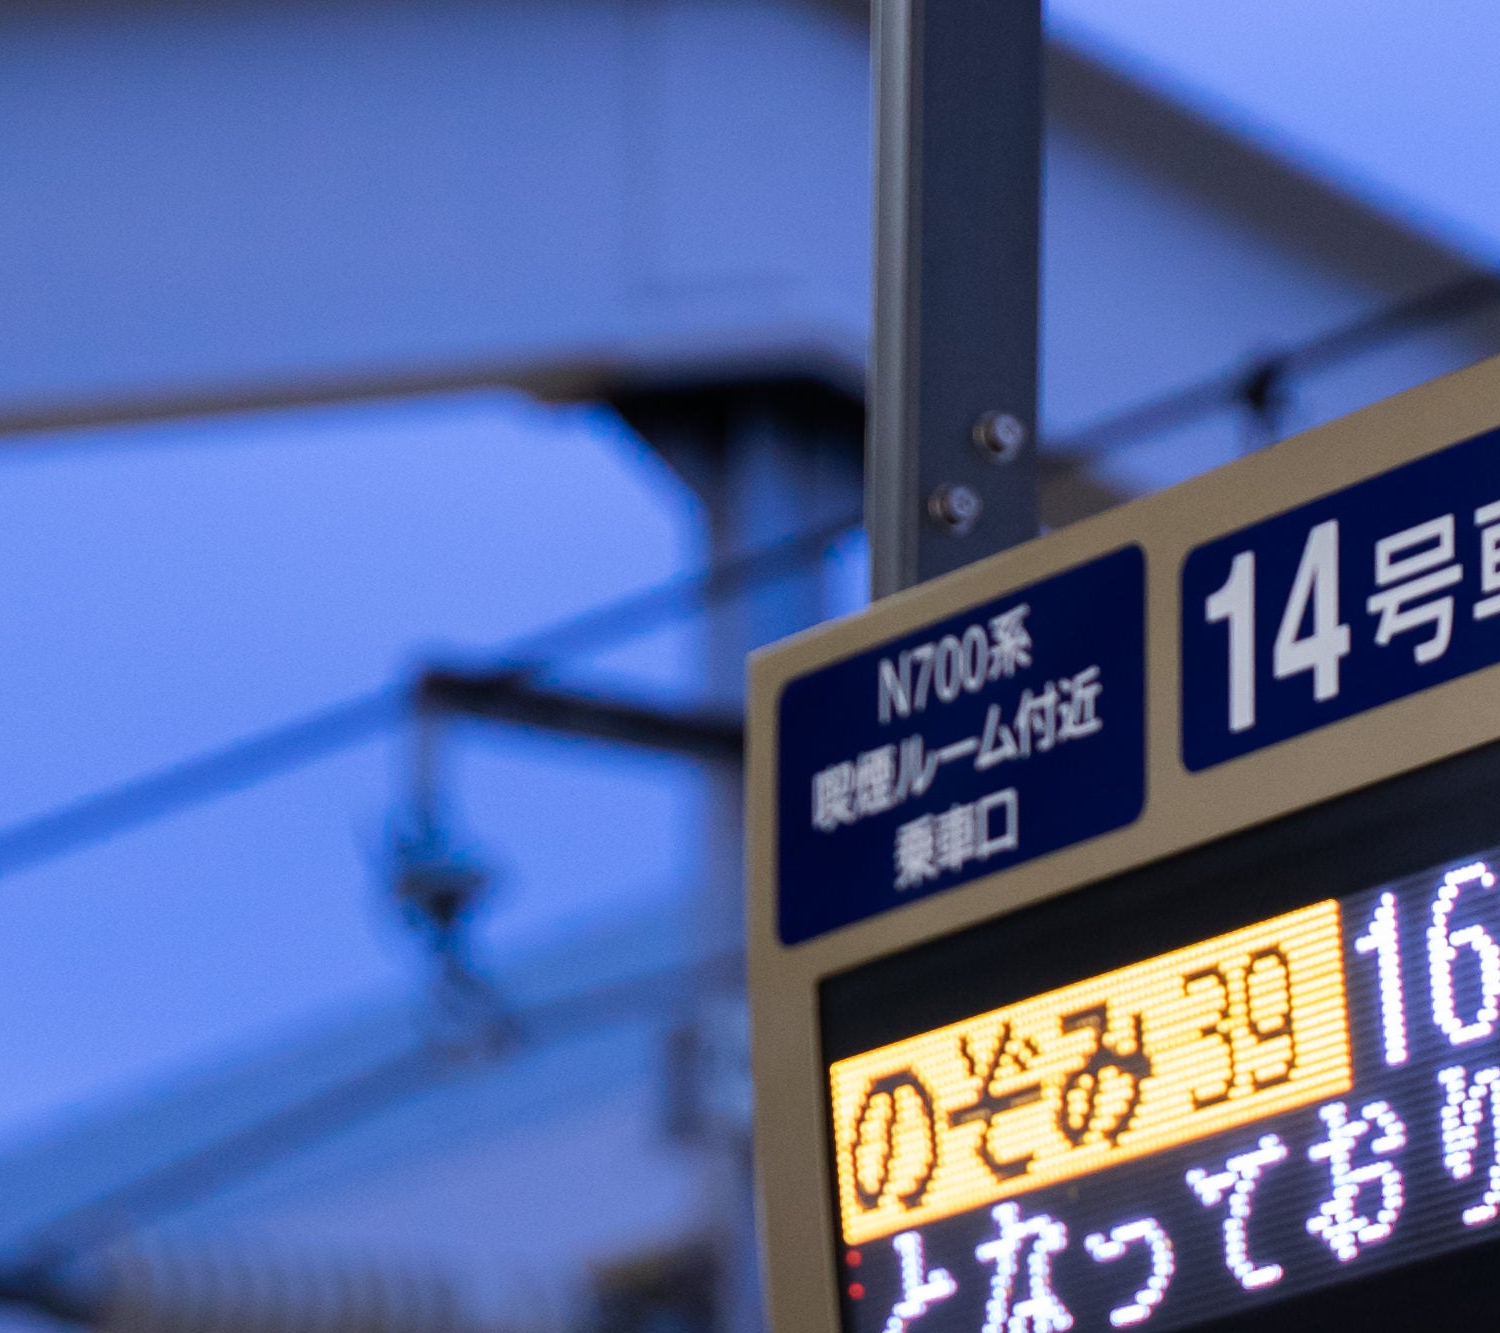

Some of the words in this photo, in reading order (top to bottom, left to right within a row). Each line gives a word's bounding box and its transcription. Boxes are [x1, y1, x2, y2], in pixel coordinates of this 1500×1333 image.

[878, 602, 1031, 723] N700系
[811, 664, 1102, 832] 喫煙ルーム付近
[894, 786, 1018, 891] 乗車口
[853, 1000, 1152, 1210] のぞみ
[1184, 944, 1296, 1111] 39
